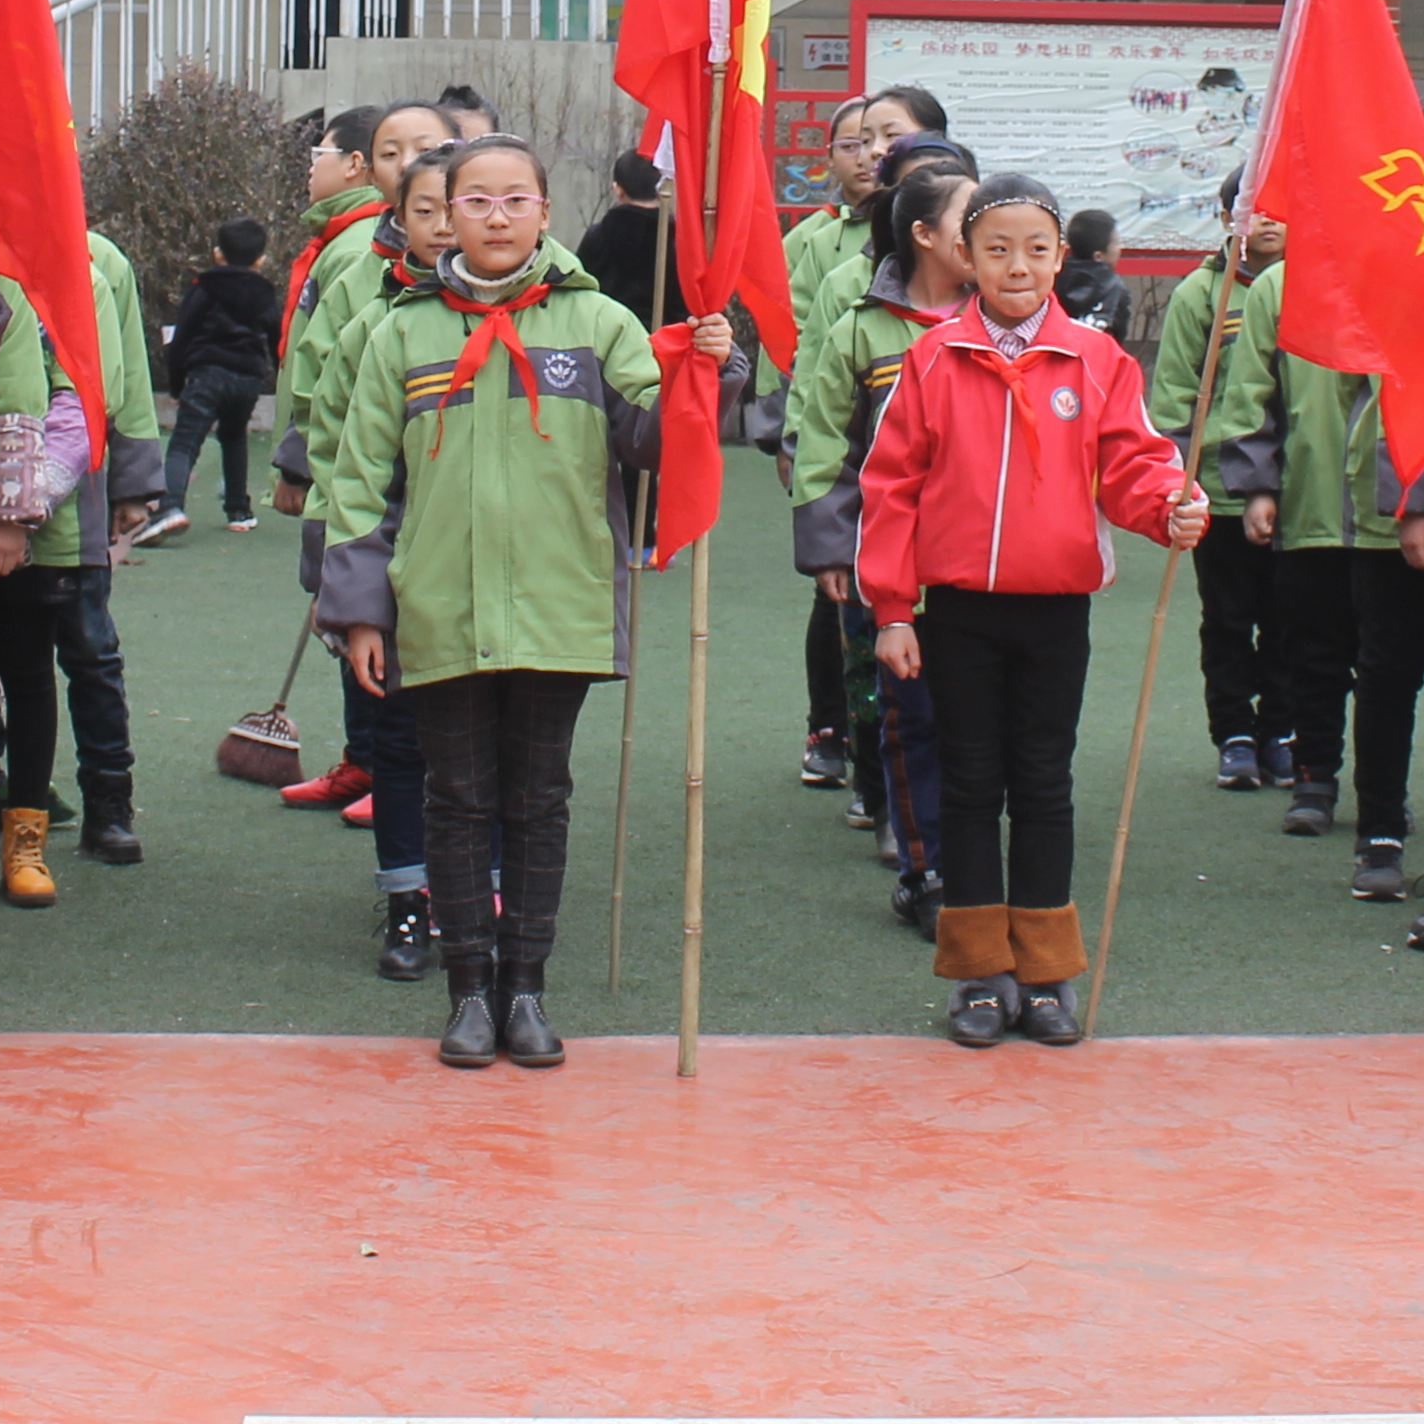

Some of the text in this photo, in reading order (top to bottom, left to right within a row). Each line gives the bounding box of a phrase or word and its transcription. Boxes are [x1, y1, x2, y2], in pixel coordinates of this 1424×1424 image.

[821, 41, 850, 51] 小心
[920, 40, 998, 57] 缤纷校园
[1014, 42, 1092, 58] 梦想社团
[1109, 44, 1186, 60] 欢乐童年
[821, 53, 850, 63] 请勿
